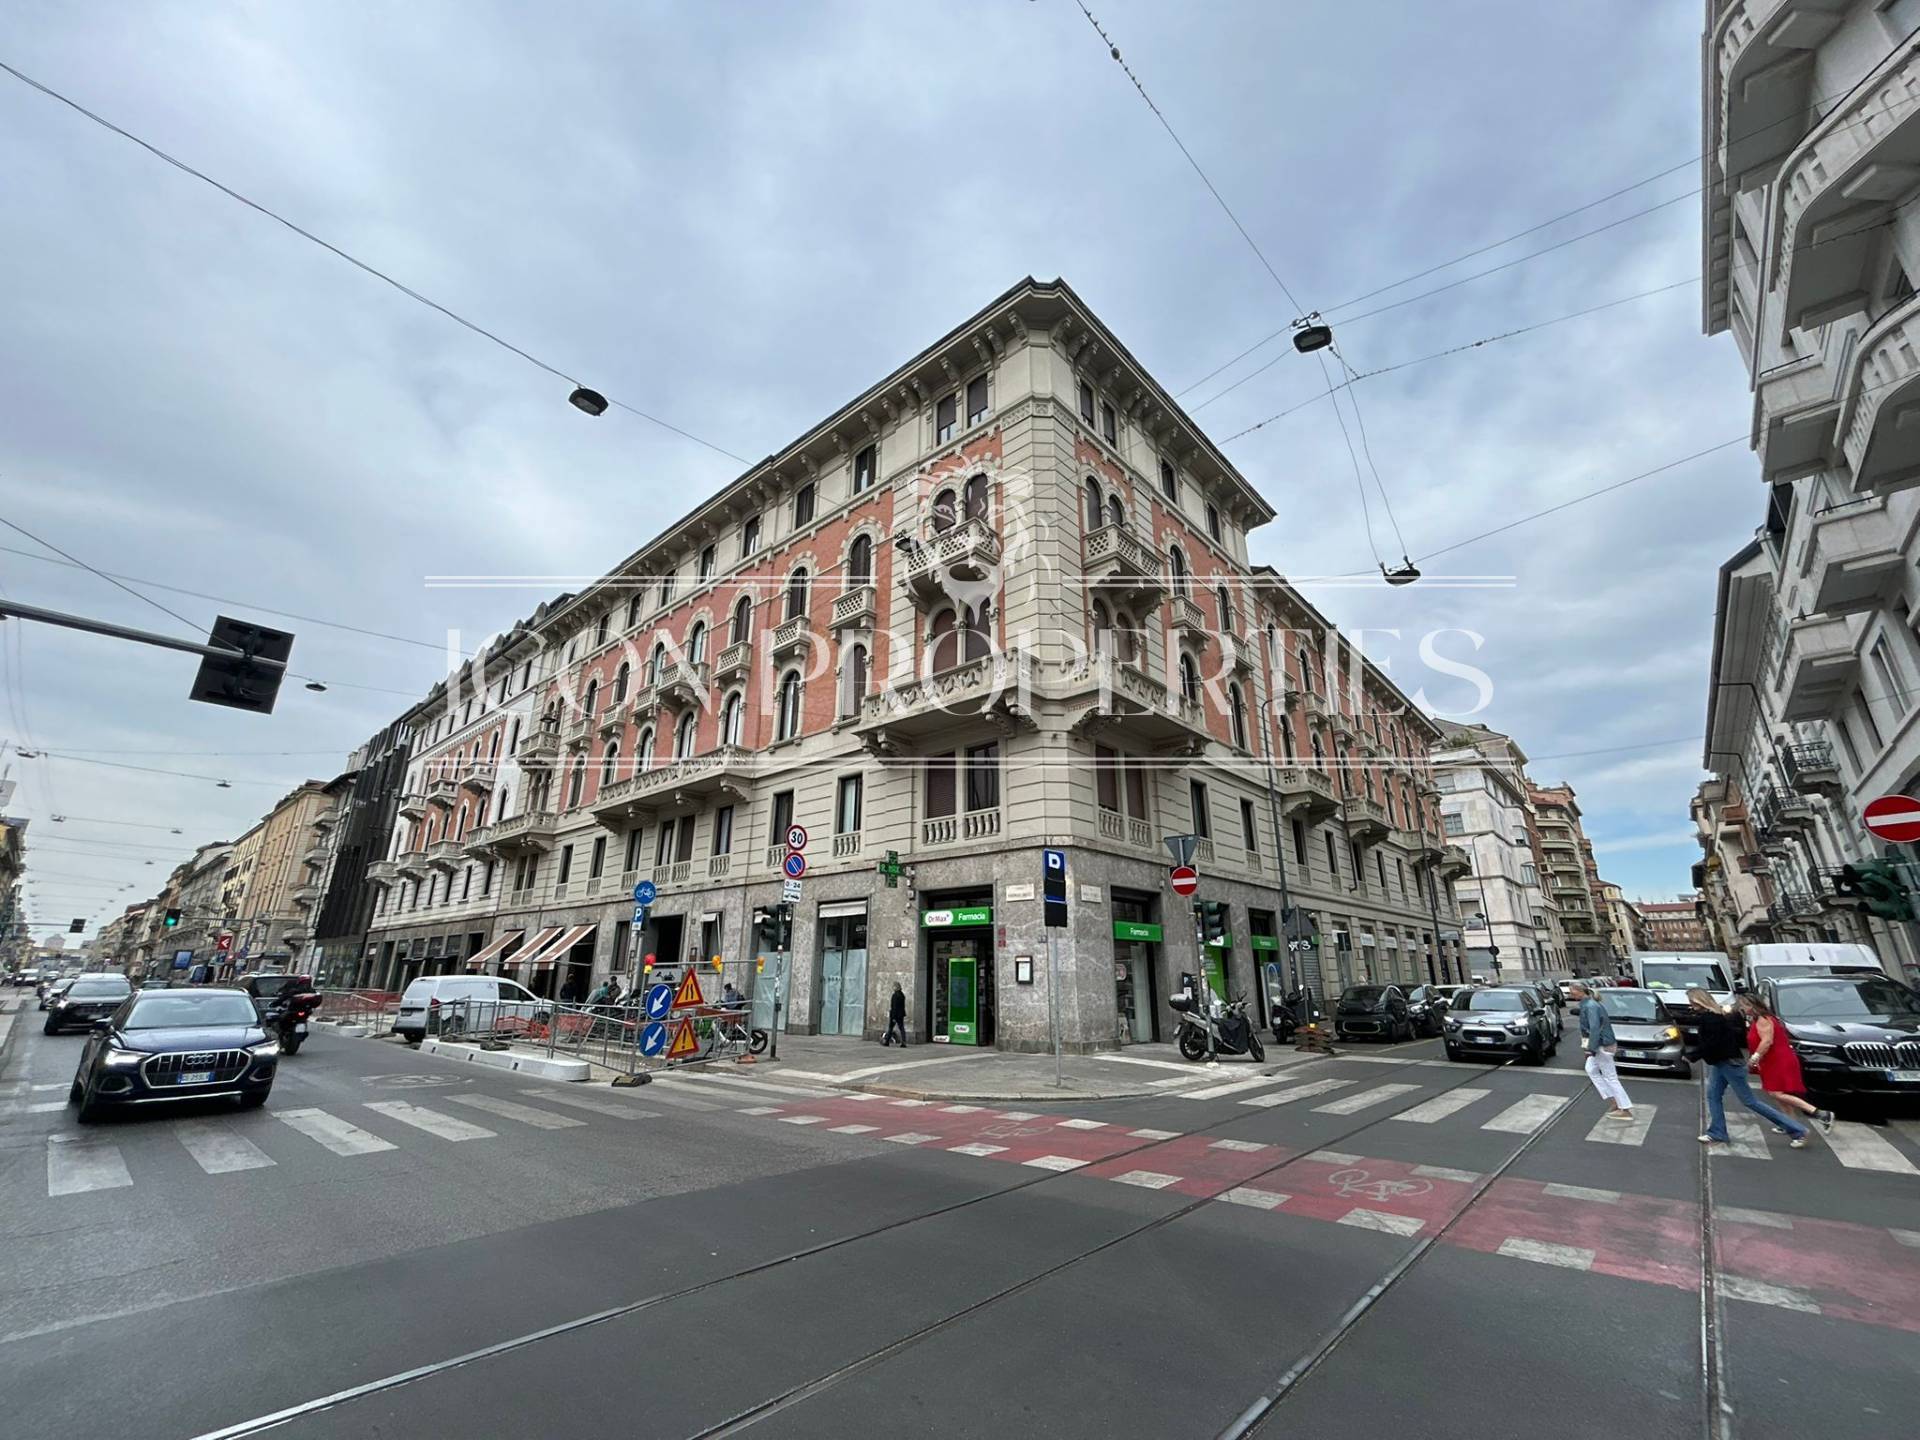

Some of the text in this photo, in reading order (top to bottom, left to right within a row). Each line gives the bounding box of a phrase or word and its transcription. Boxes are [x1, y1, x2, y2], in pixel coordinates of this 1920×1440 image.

[790, 831, 803, 844] 30
[635, 907, 642, 920] P
[958, 912, 986, 921] Farmacia
[1130, 927, 1149, 936] Farmacia
